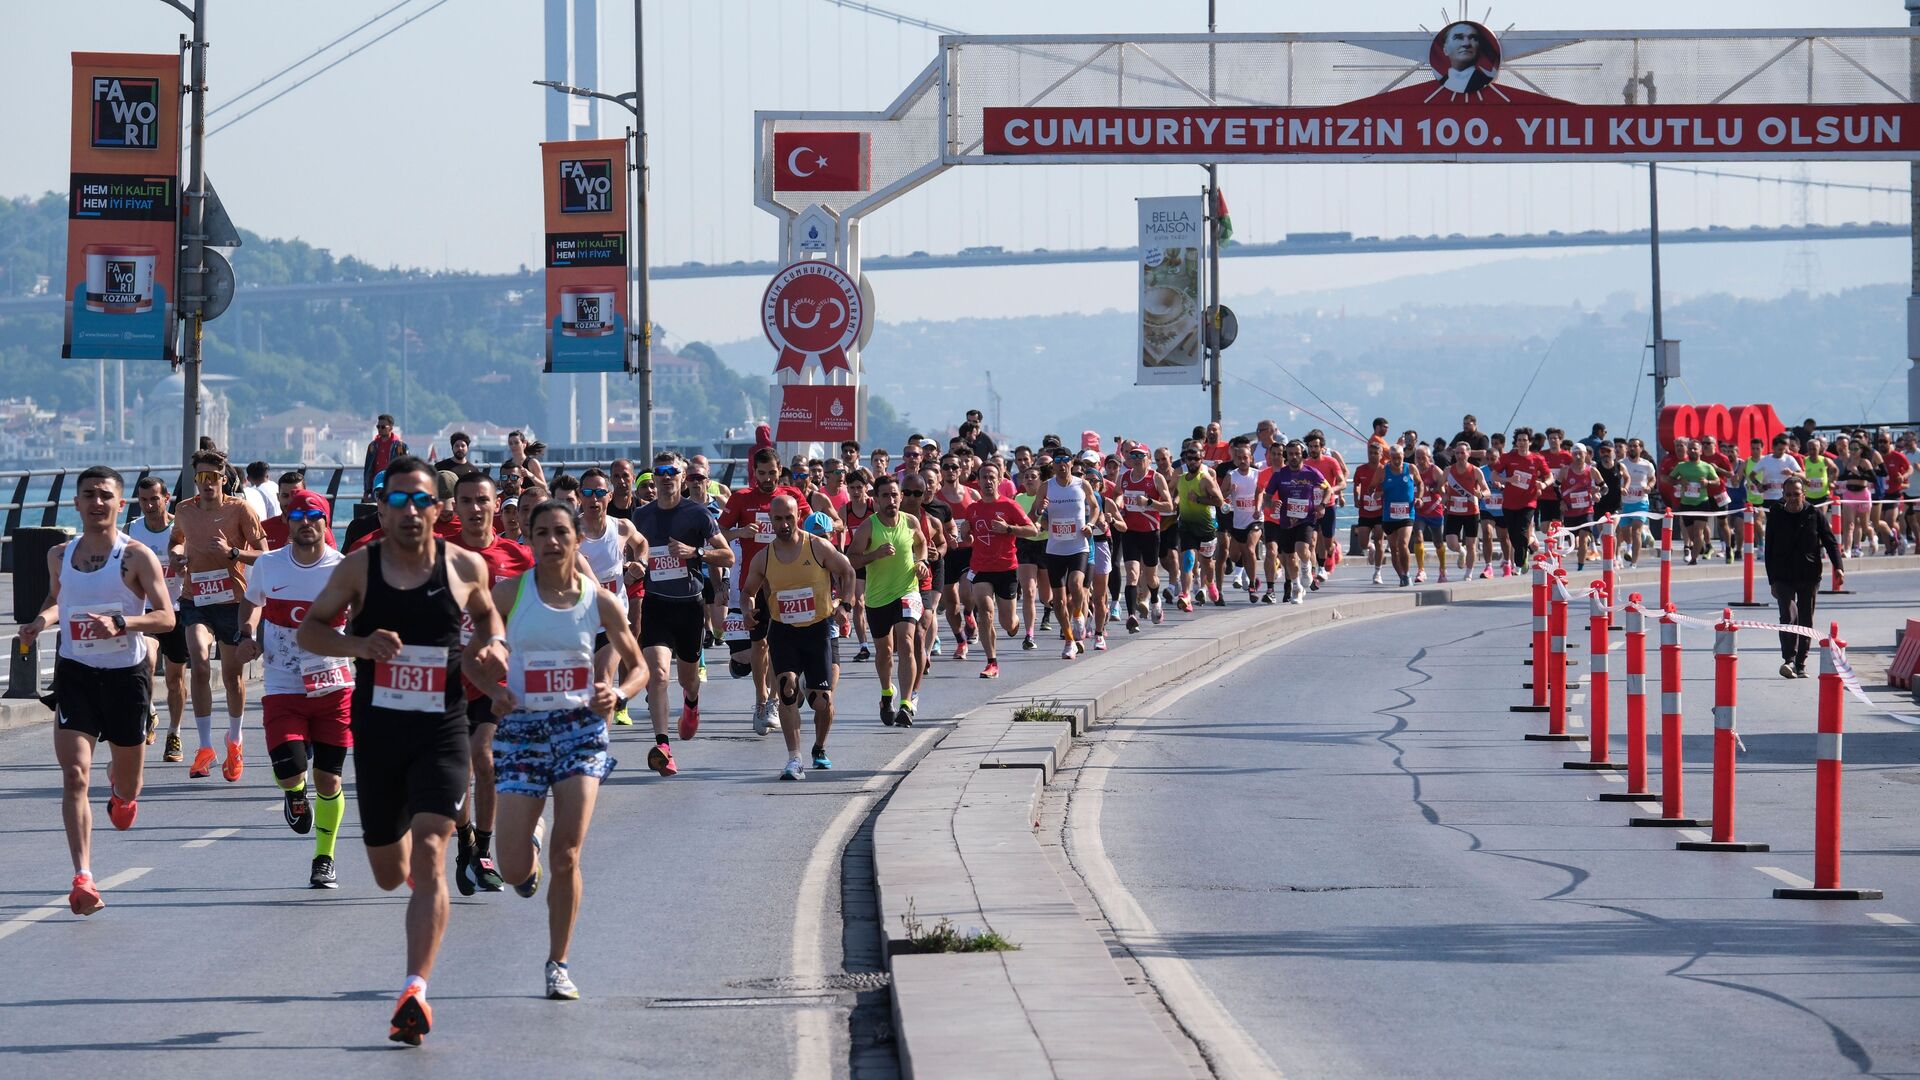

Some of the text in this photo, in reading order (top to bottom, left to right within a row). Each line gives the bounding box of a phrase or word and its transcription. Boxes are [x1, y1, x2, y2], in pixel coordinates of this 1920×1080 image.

[94, 79, 124, 101] FA
[110, 101, 156, 123] WO
[125, 123, 148, 146] RI
[1416, 117, 1502, 146] 100.
[1516, 117, 1593, 146] YILI
[1608, 116, 1742, 146] KUTLU
[1757, 115, 1901, 145] OLSUN
[561, 161, 586, 178] FA
[83, 184, 108, 195] HEM
[125, 184, 163, 196] KALİTE
[575, 177, 611, 194] WO
[83, 198, 108, 209] HEM
[124, 197, 154, 209] FİYAT
[587, 194, 605, 211] RI
[1152, 211, 1189, 223] BELLA
[1145, 222, 1196, 234] MAISON
[556, 241, 576, 249] HEM
[556, 251, 576, 259] HEM
[107, 263, 120, 273] FA
[783, 266, 845, 285] CUMHURİYET
[114, 273, 134, 283] WO
[780, 411, 812, 419] AMOĞLU
[1056, 525, 1072, 534] 1800
[654, 556, 680, 570] 2688
[199, 580, 225, 595] 3441
[783, 599, 808, 613] 2211
[79, 622, 97, 640] 22
[312, 668, 346, 690] 2359
[390, 666, 434, 691] 1631
[544, 669, 574, 692] 156
